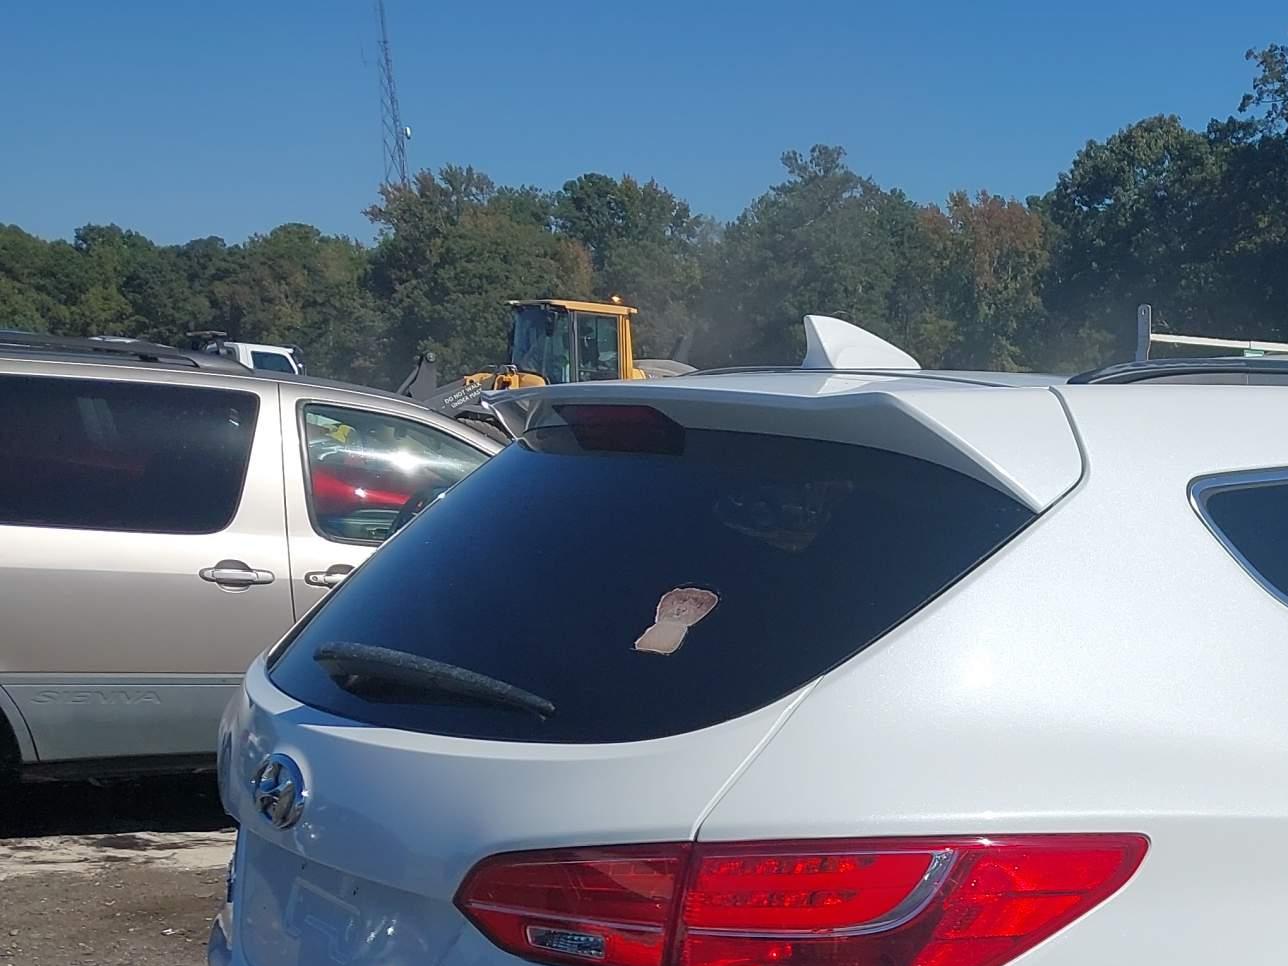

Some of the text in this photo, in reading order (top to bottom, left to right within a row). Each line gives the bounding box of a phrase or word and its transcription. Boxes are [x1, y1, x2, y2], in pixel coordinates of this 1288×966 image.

[444, 382, 482, 404] DO NOT WALK
[451, 396, 470, 408] UNDER
[31, 690, 162, 704] SIENNA
